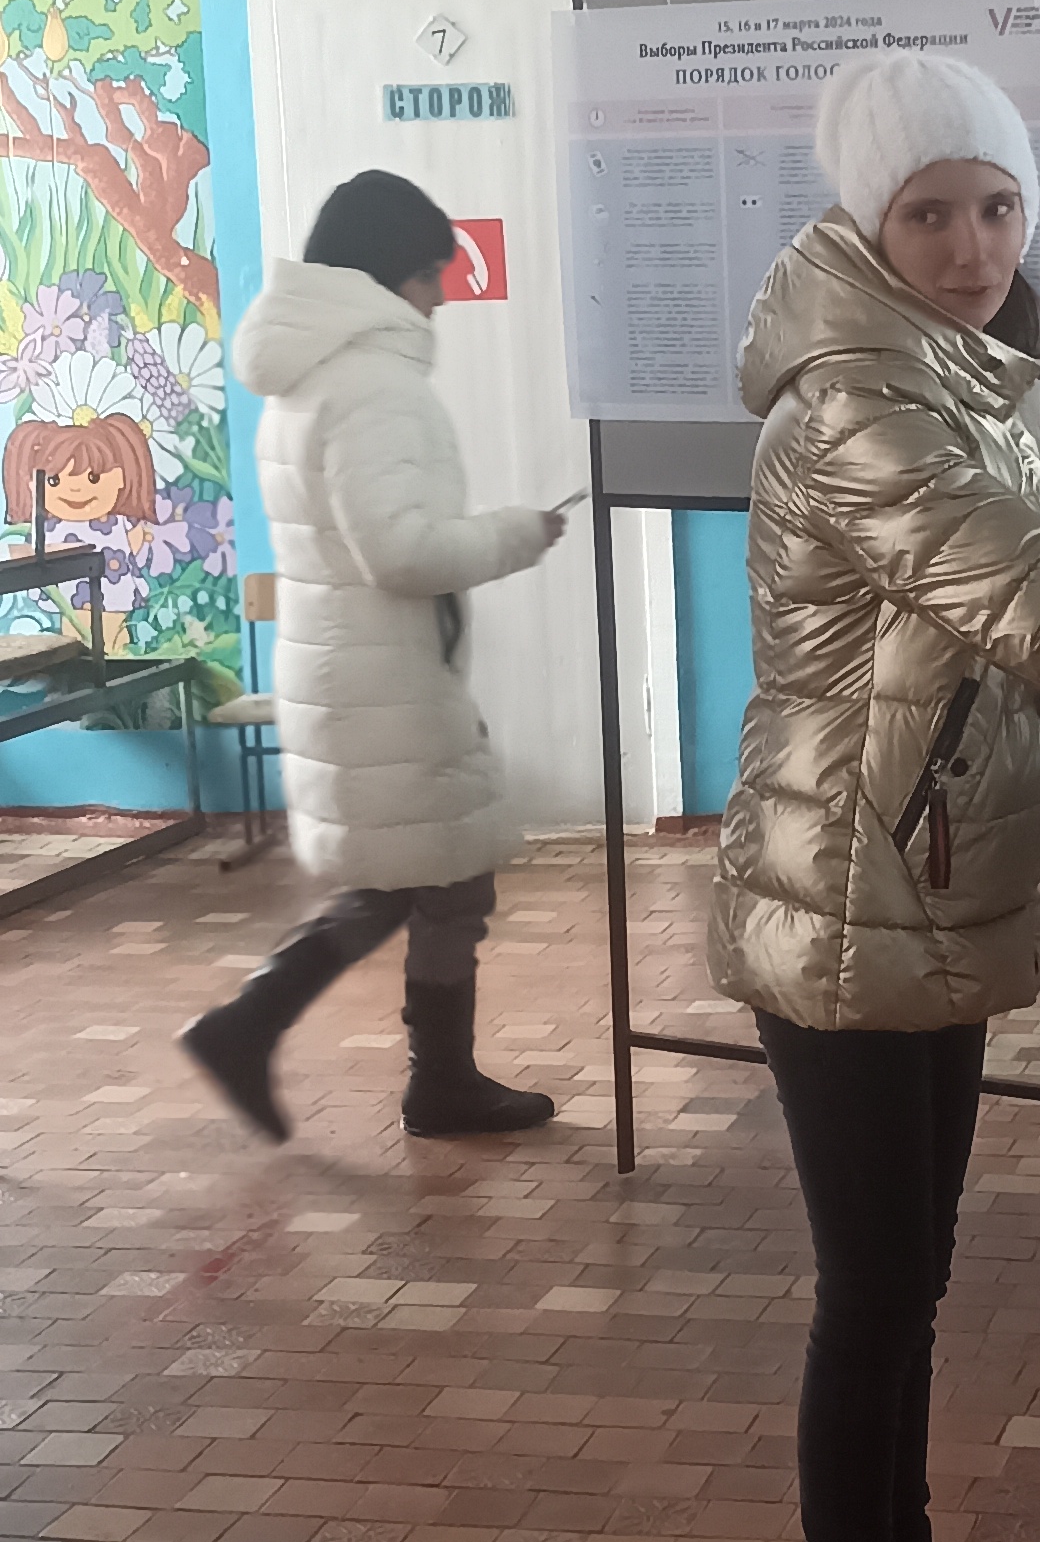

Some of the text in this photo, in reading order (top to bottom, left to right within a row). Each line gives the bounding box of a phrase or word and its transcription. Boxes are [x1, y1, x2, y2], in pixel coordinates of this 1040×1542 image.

[717, 15, 883, 34] 15, 16 и 17 марта 2024 года
[431, 28, 447, 55] 7
[639, 31, 969, 60] Выборы Президента Российской Федерации
[674, 65, 768, 86] ПОРЯДОК
